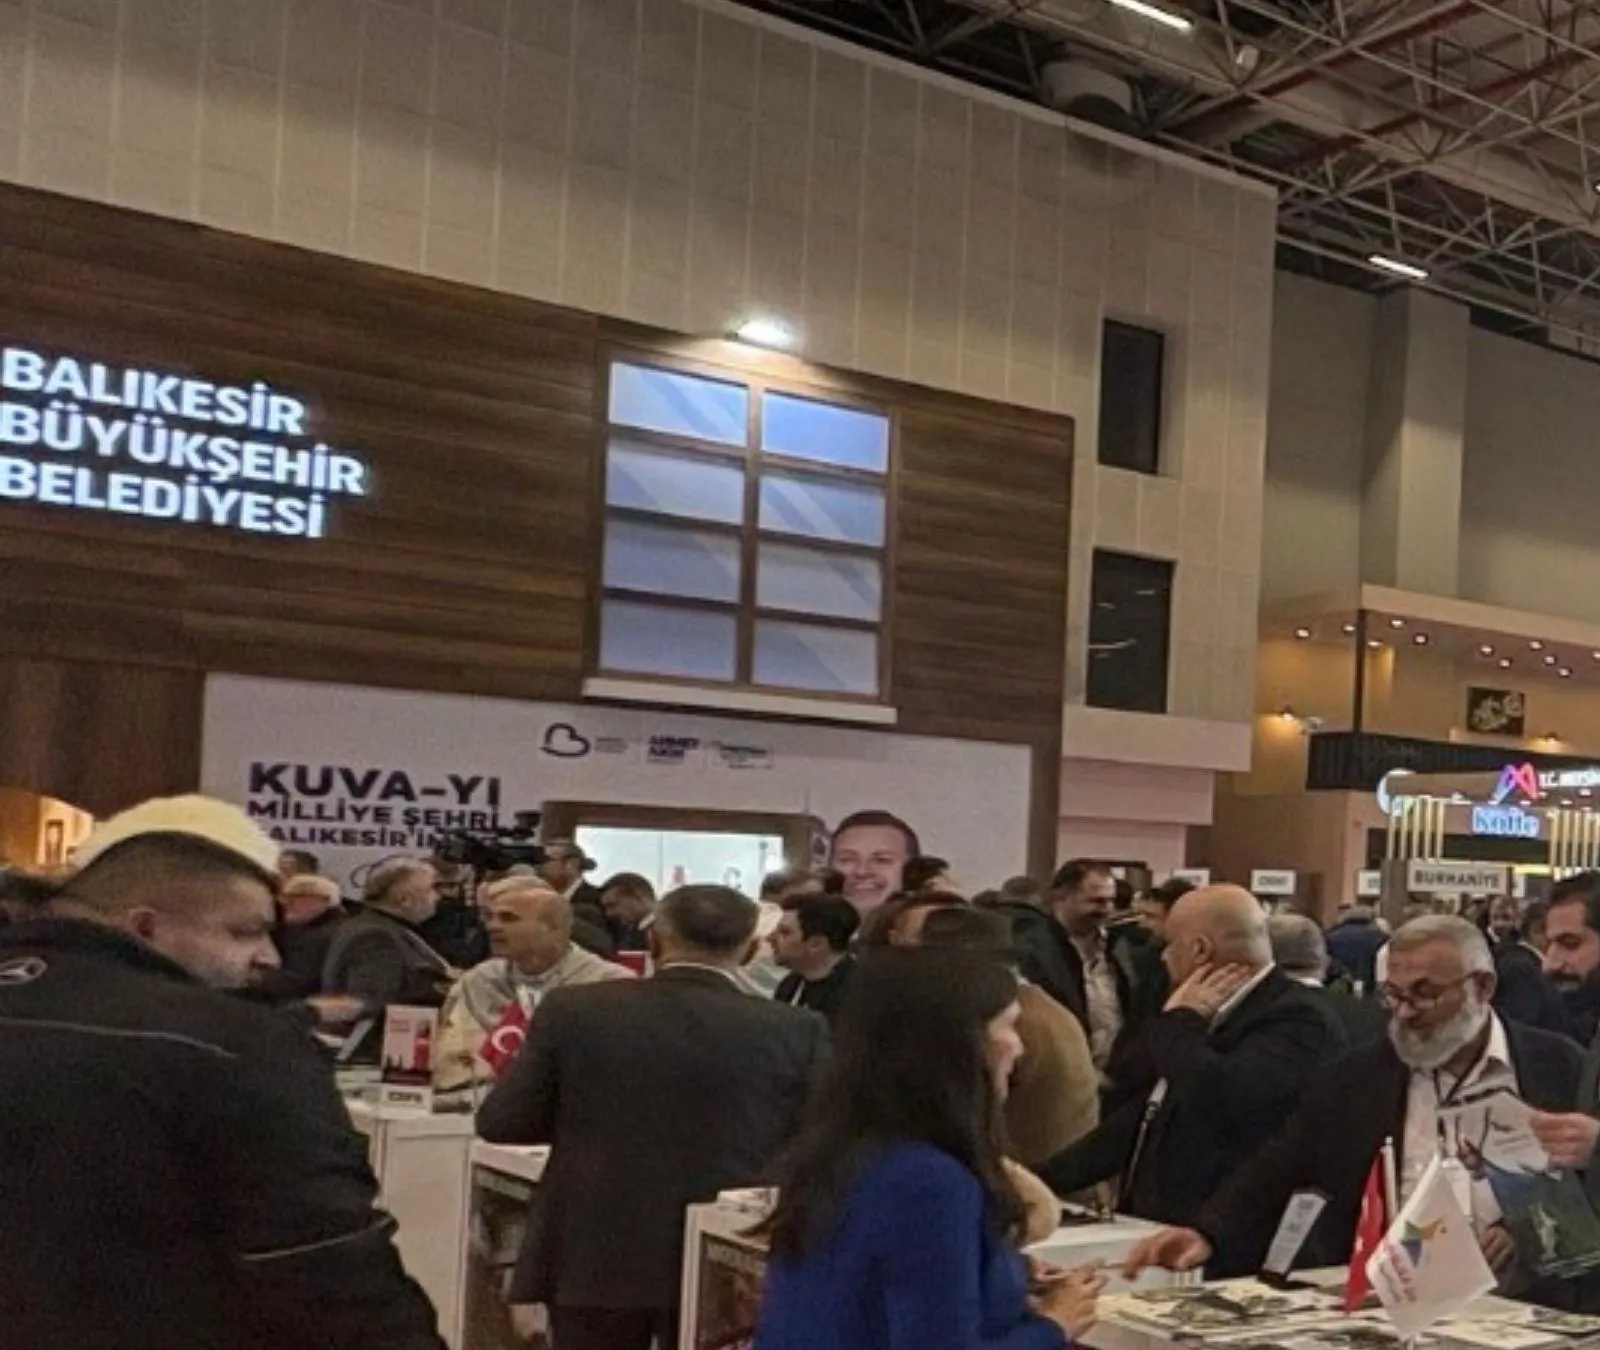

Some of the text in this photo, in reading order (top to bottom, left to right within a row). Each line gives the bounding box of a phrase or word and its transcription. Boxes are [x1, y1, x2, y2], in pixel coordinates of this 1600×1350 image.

[1, 347, 306, 437] BALIKESİR
[0, 400, 367, 497] BÜYÜKŞEHİR
[0, 455, 325, 540] BELEDİYESİ
[247, 797, 393, 824] MİLLİYE
[249, 761, 501, 805] KUVA-YI
[270, 825, 443, 849] ALIKESİR'İN
